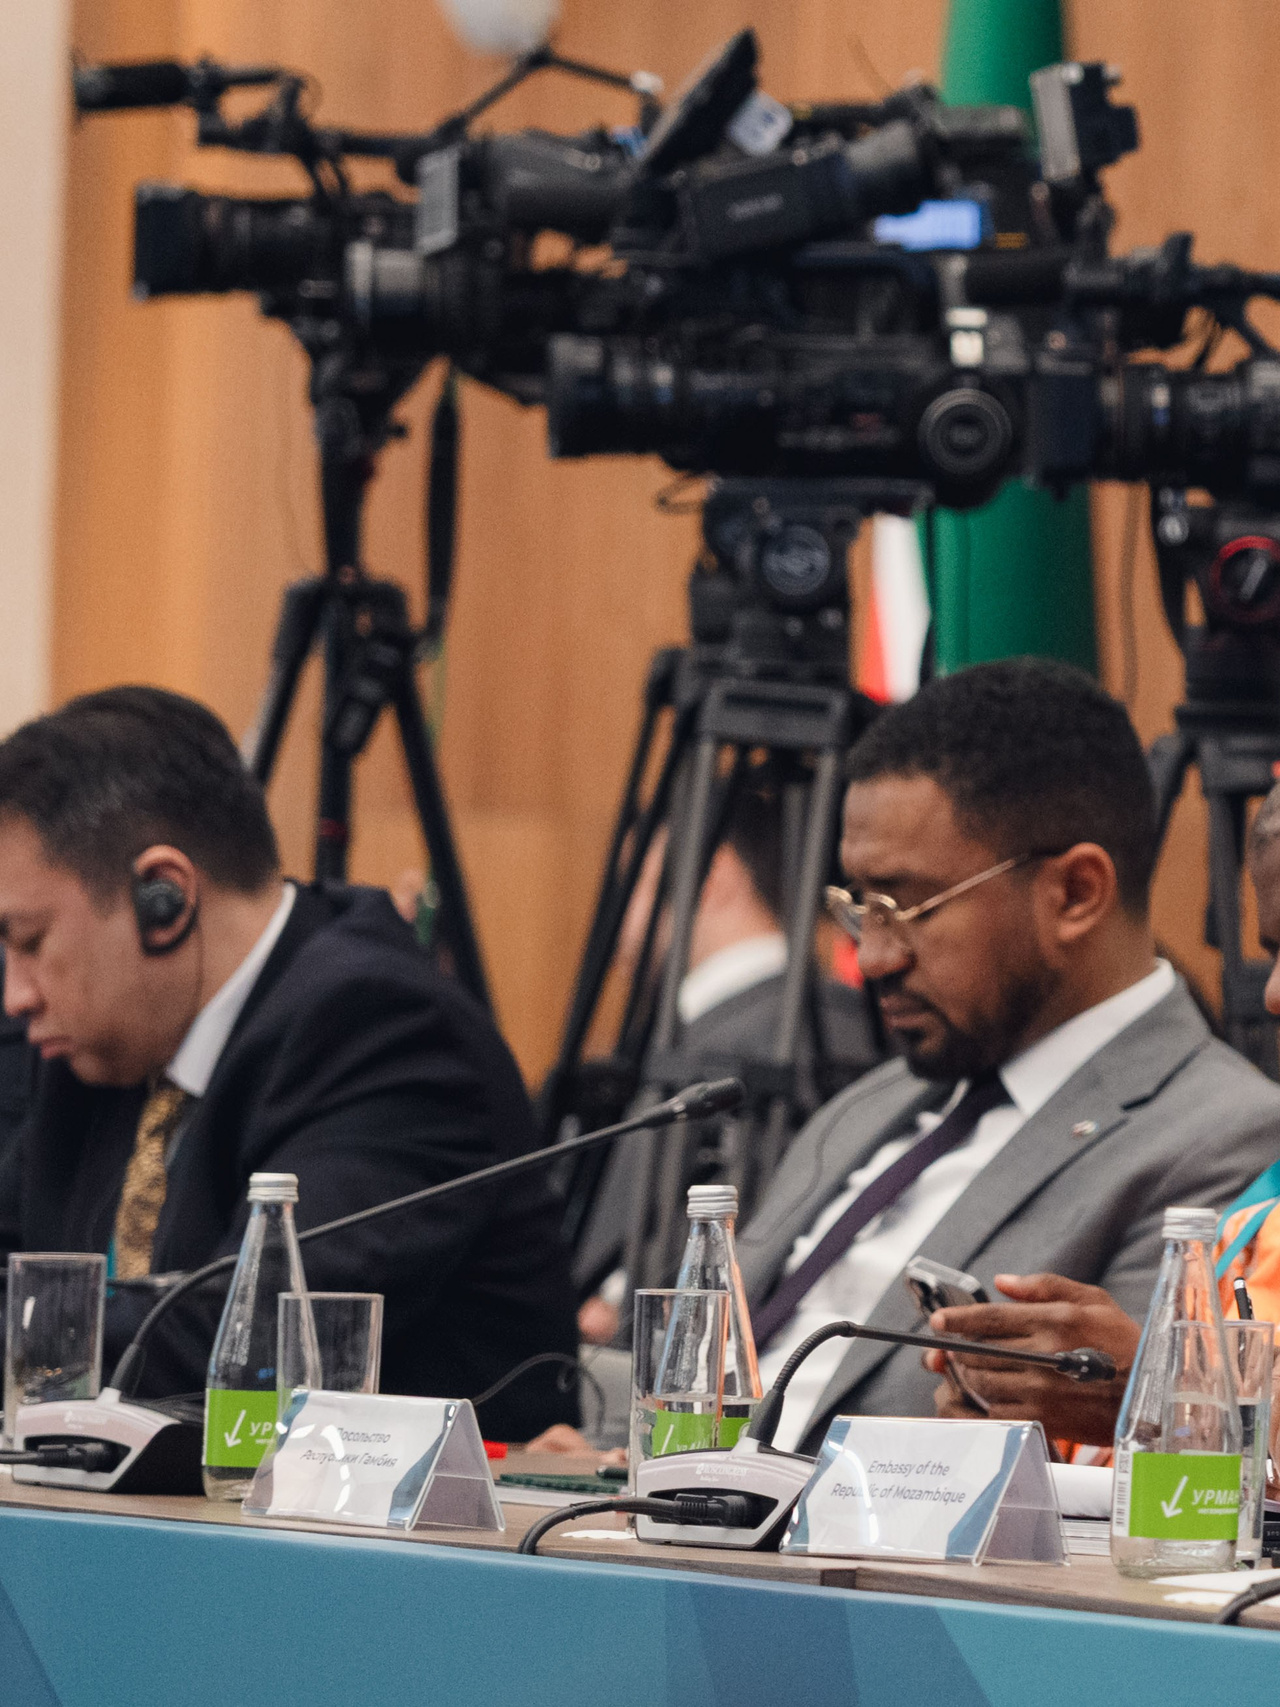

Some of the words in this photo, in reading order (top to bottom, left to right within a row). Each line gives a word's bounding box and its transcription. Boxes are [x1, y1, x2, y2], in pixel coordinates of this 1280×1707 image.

[358, 1452, 398, 1467] Гамбия
[868, 1460, 915, 1477] Embassy
[916, 1461, 932, 1475] of
[929, 1461, 950, 1476] the
[830, 1483, 880, 1500] Repulic
[879, 1484, 897, 1498] of
[894, 1486, 966, 1505] Mozambique
